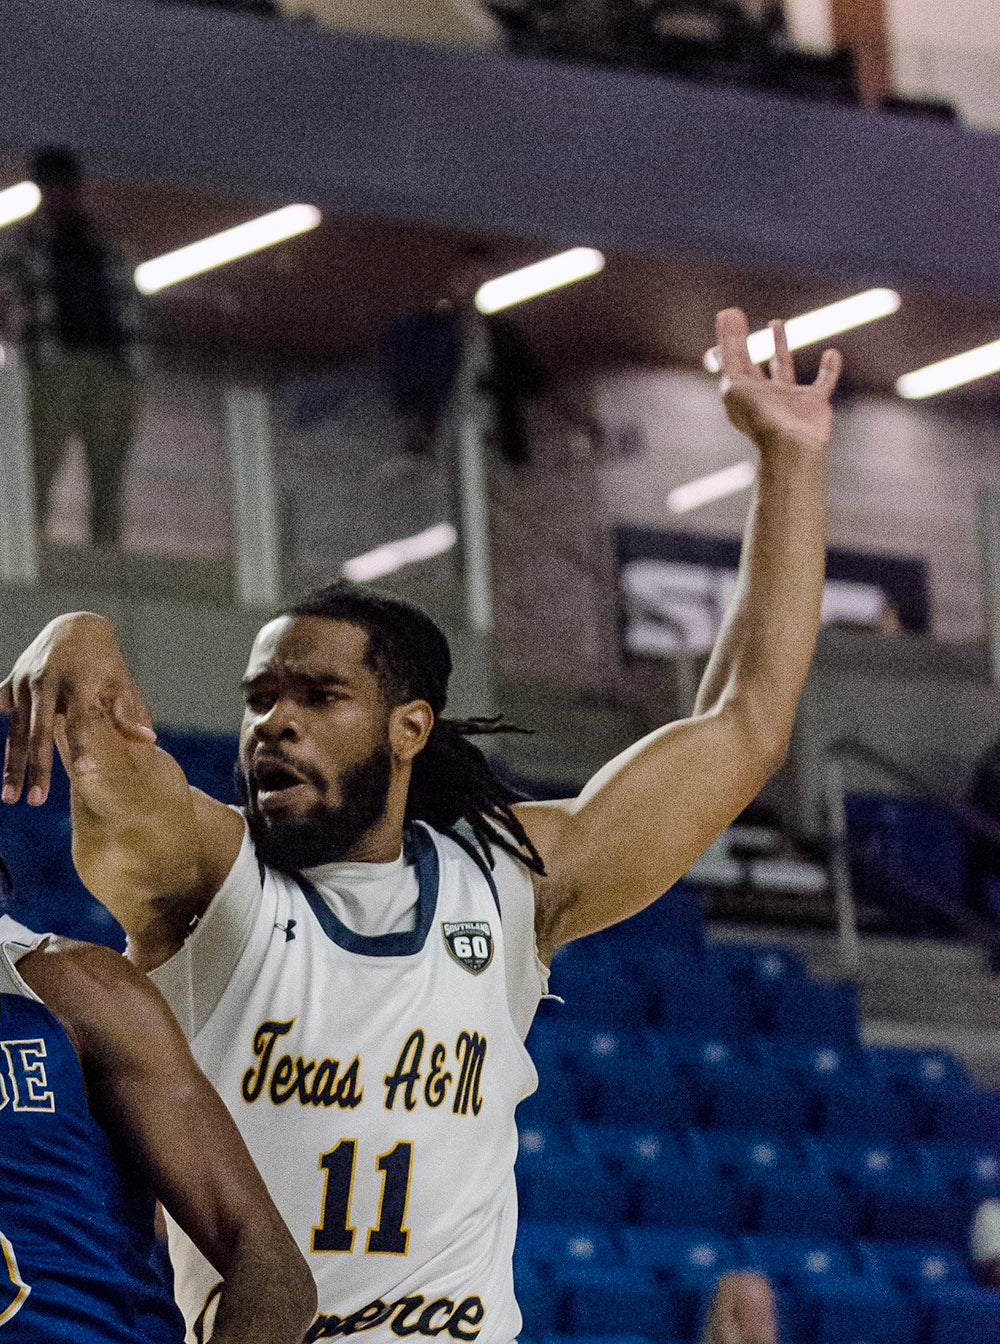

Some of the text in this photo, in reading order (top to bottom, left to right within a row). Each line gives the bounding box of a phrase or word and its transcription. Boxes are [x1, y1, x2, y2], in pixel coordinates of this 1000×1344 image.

[453, 936, 489, 959] 60
[241, 1016, 487, 1117] Texas A&M
[310, 1137, 414, 1257] 11
